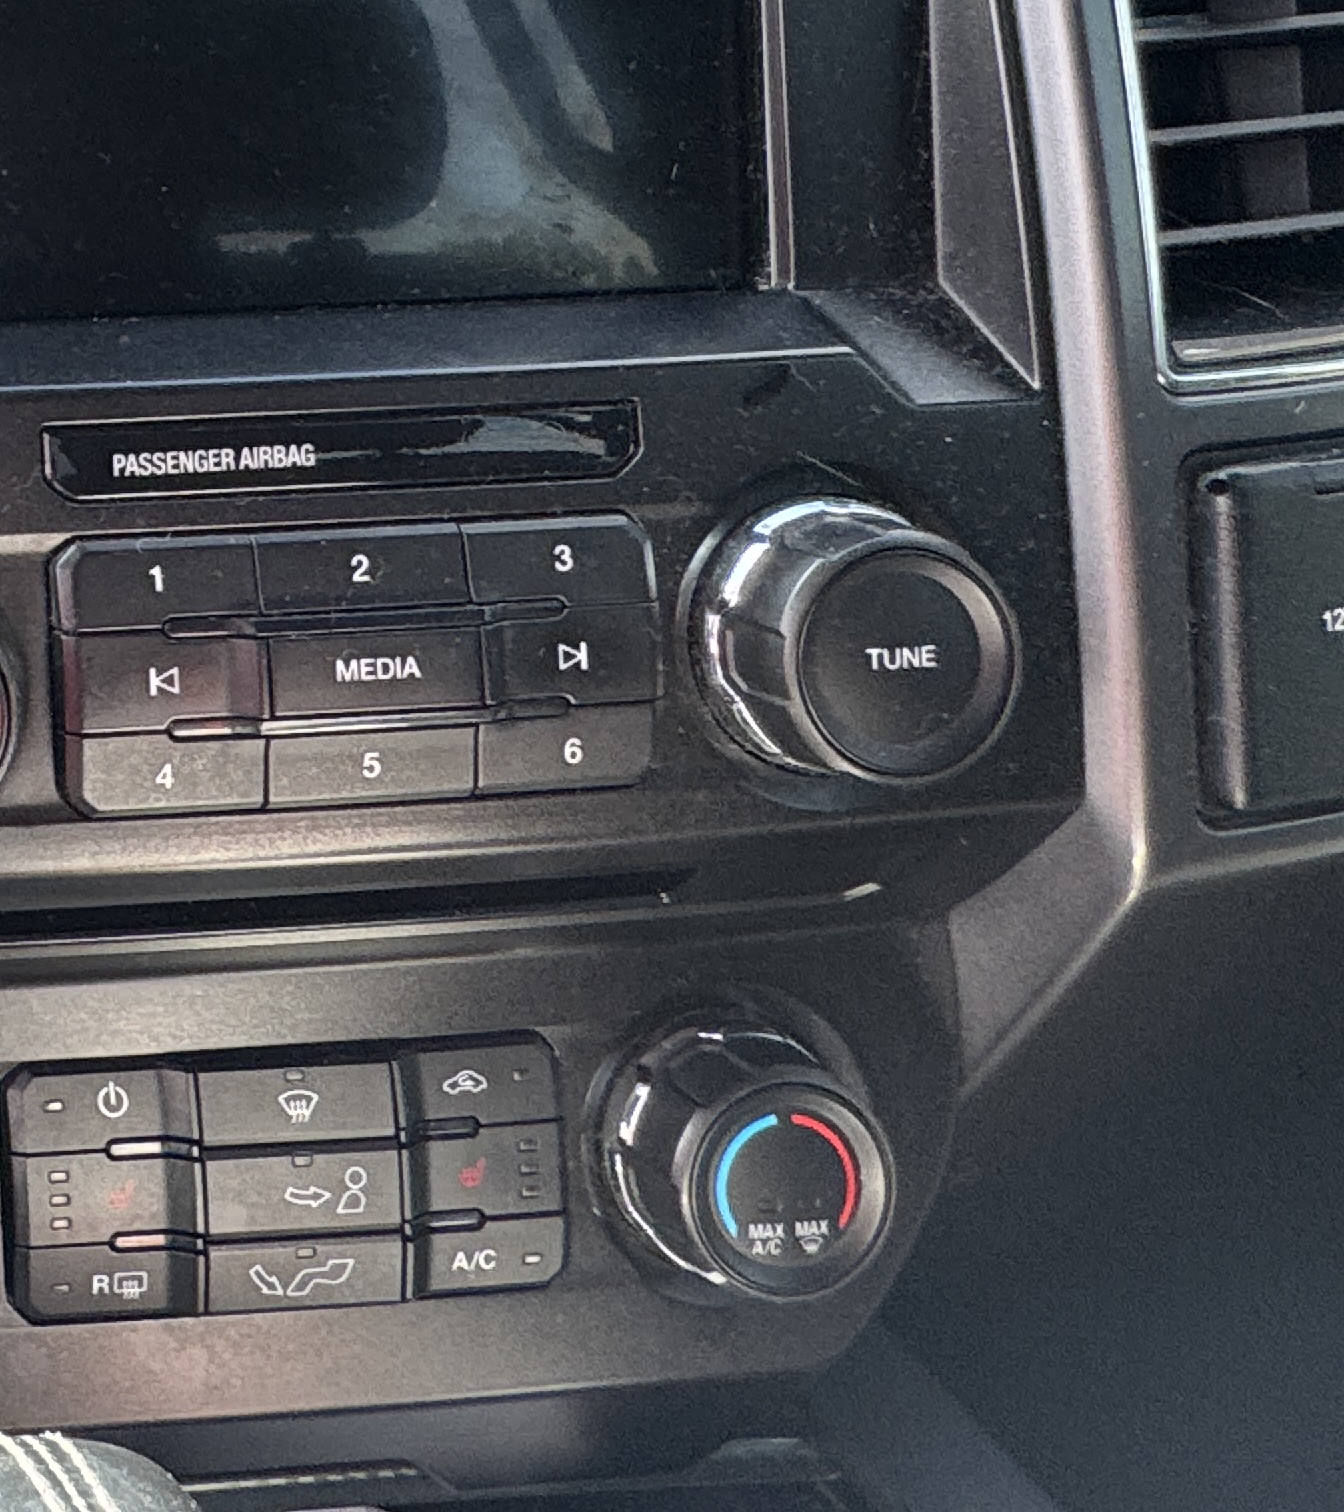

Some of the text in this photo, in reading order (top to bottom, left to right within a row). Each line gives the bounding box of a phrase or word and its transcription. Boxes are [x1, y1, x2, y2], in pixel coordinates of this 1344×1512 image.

[112, 443, 316, 477] PASSENGER AIRBAG
[350, 554, 372, 583] 2
[554, 544, 574, 572] 3
[148, 564, 165, 593] 1
[335, 656, 422, 683] MEDIA
[865, 644, 938, 671] TUNE
[563, 738, 583, 764] 6
[155, 763, 175, 790] 4
[362, 752, 382, 779] 5
[748, 1222, 785, 1239] MAX
[794, 1219, 830, 1237] MAX
[451, 1248, 498, 1272] A/C
[752, 1239, 783, 1256] A/C
[92, 1274, 110, 1296] R
